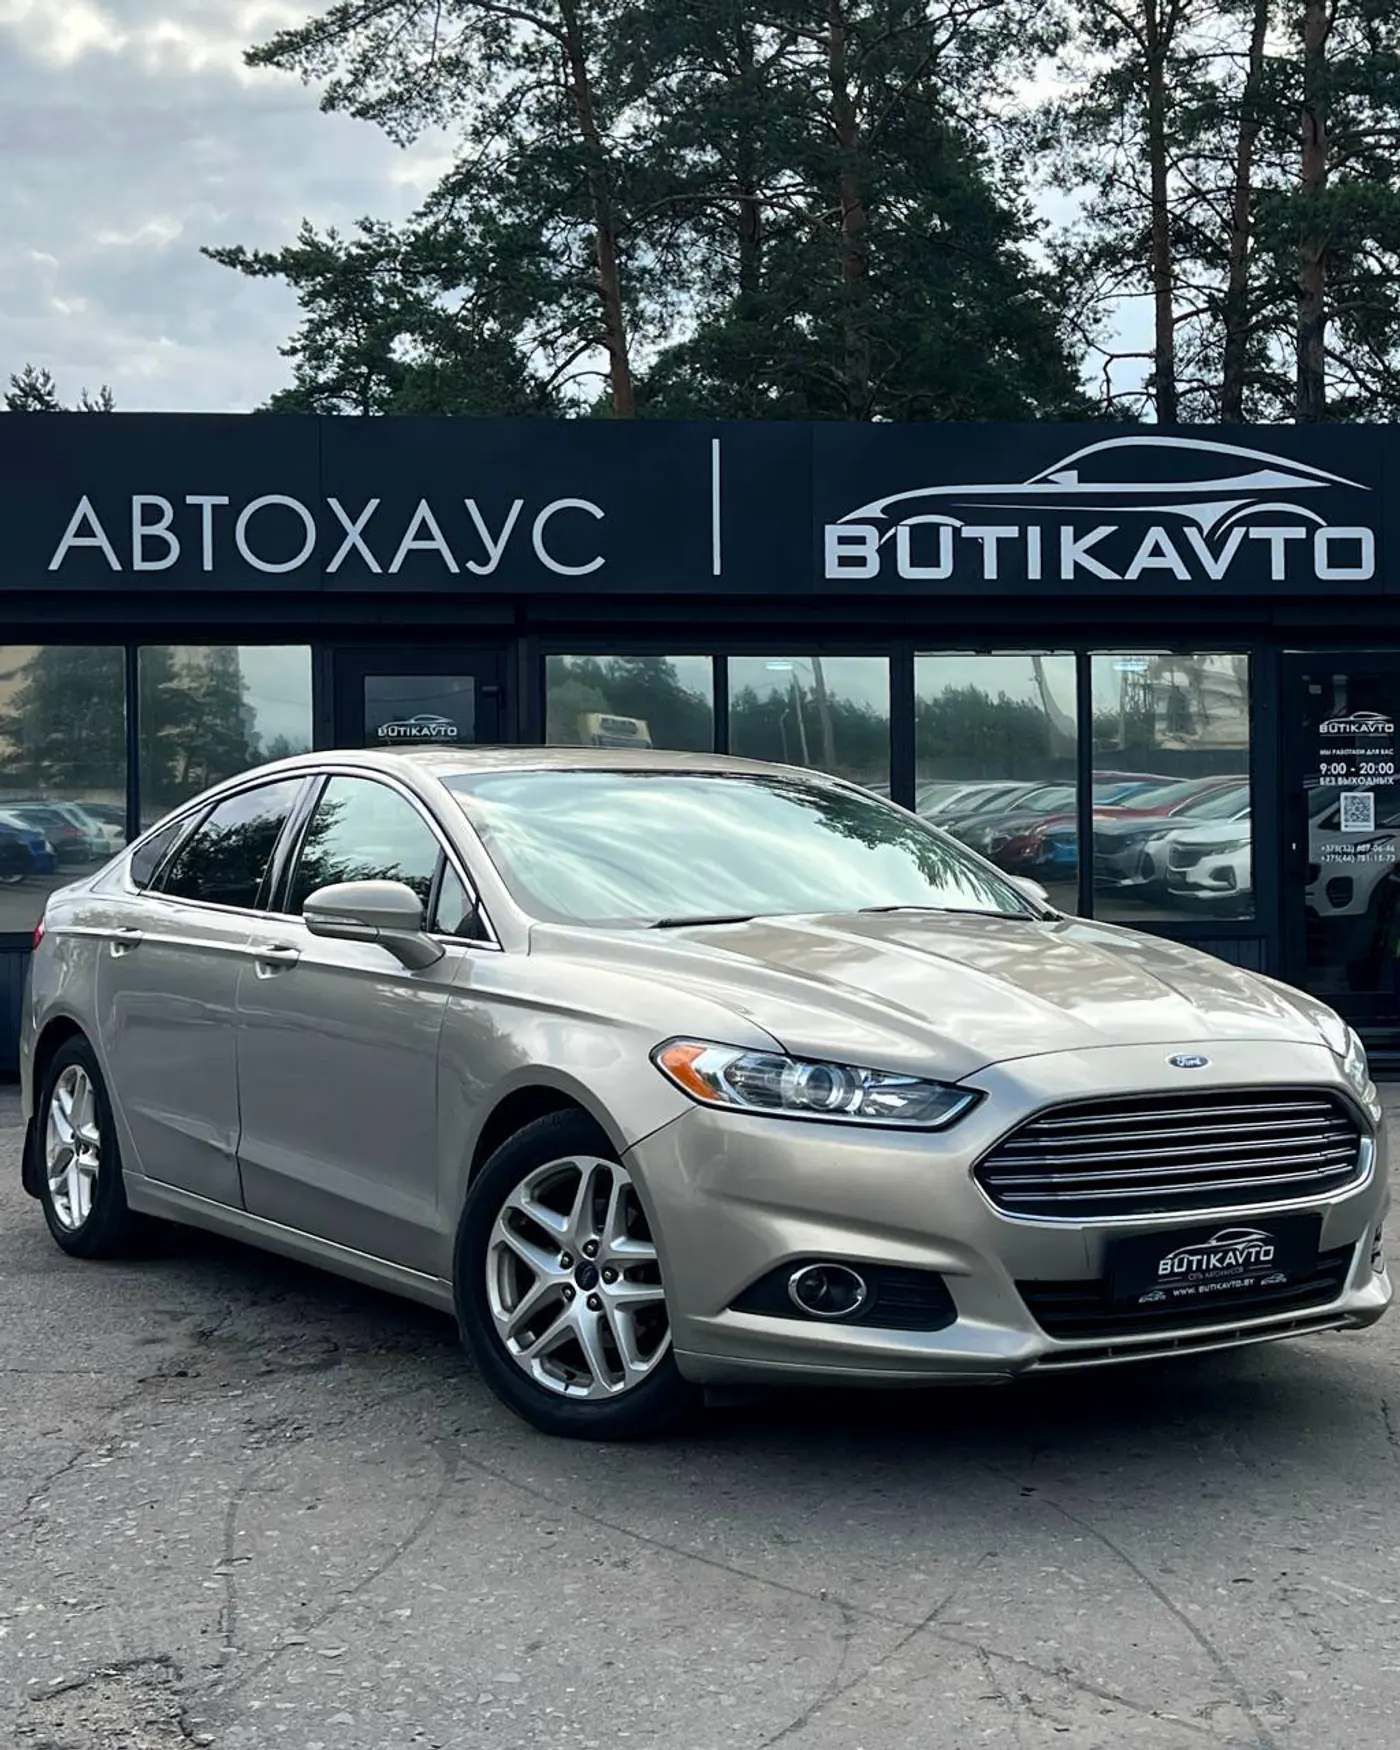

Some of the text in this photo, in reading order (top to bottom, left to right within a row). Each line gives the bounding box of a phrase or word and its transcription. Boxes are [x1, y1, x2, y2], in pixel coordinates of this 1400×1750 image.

[48, 494, 606, 576] АВТОХАУС
[824, 523, 1375, 581] BUTIKAVTO
[377, 726, 458, 737] BUTIKAVTO
[1319, 723, 1395, 733] BUTIKAVTO
[1319, 762, 1347, 775] 9:00
[1359, 762, 1395, 775] 20:00
[1320, 777, 1394, 785] БЕЗ ВЫХОДНЫХ
[1175, 1055, 1204, 1067] Ford
[1158, 1245, 1275, 1275] BUTIKAVTO
